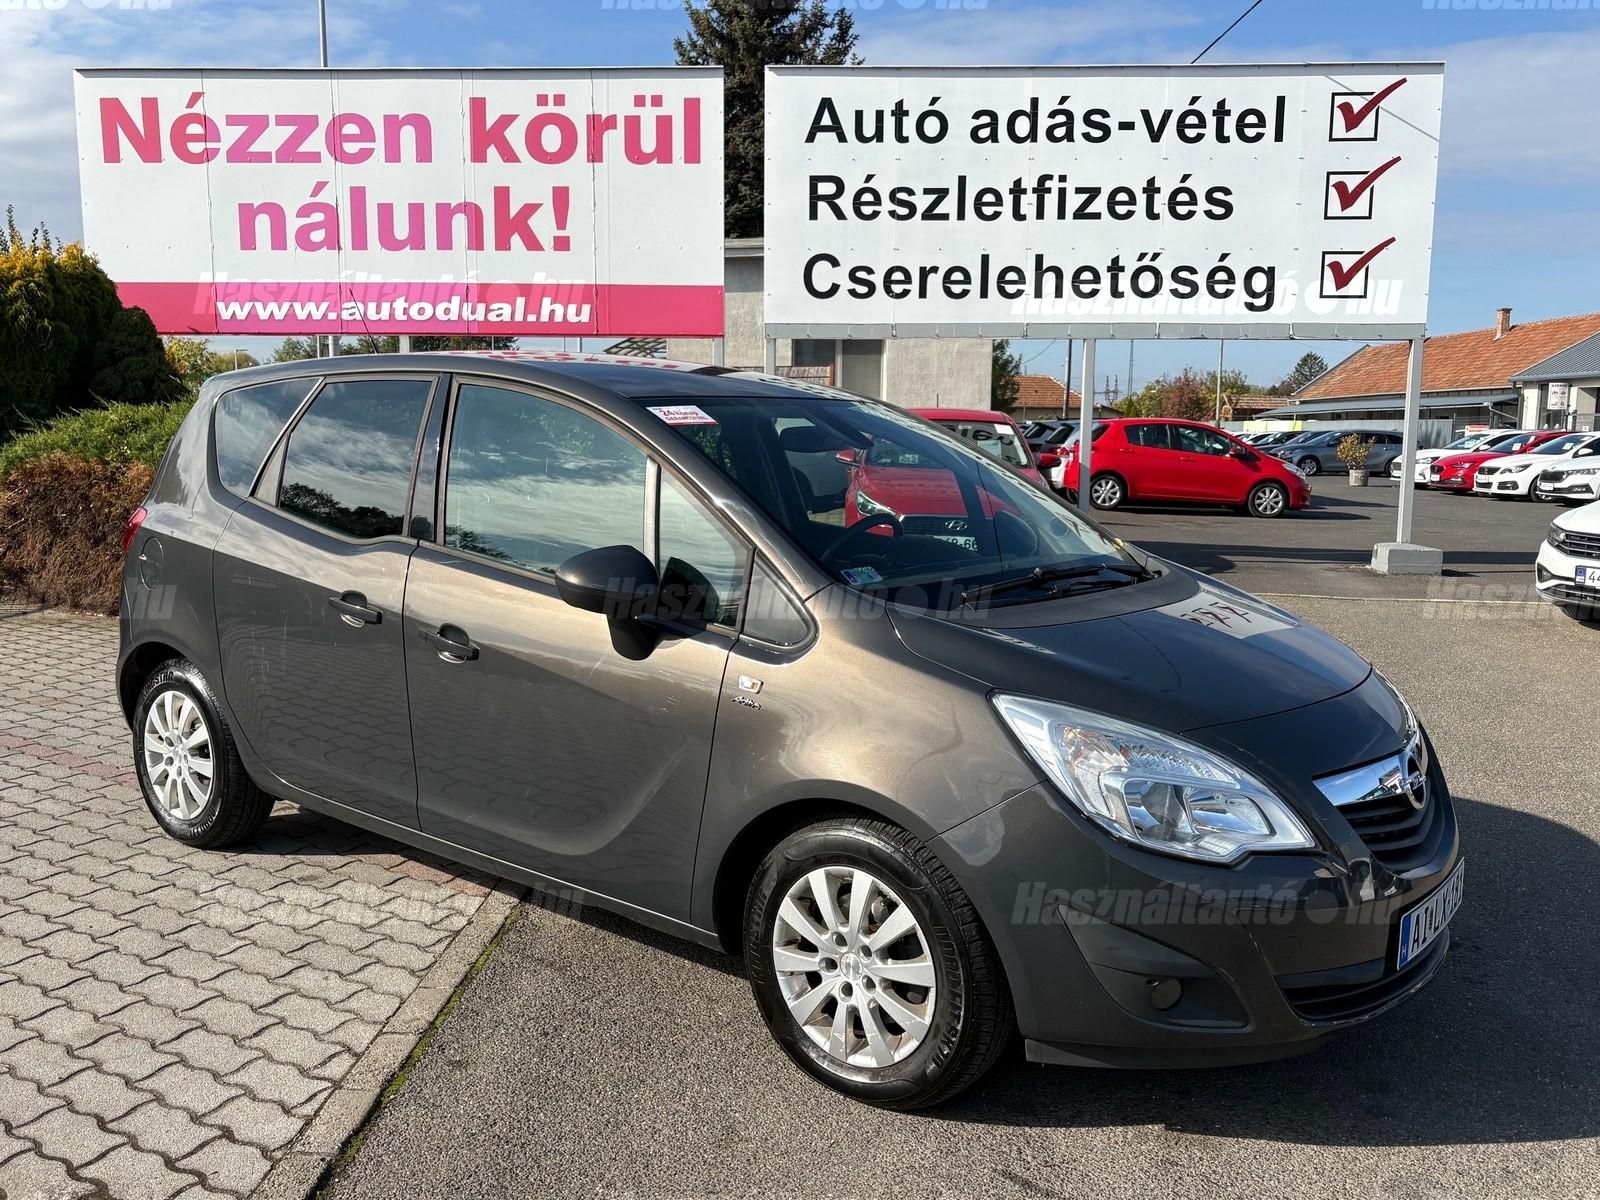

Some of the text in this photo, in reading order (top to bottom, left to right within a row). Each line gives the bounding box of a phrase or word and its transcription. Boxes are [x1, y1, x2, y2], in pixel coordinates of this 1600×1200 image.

[99, 91, 701, 165] Nézzen körül
[804, 95, 1286, 144] Autó adás-vétel
[238, 181, 571, 252] nálunk!
[808, 173, 1234, 222] Részletfizetés
[216, 295, 591, 323] www.autodual.hu
[801, 252, 1276, 312] Cserelehetőség
